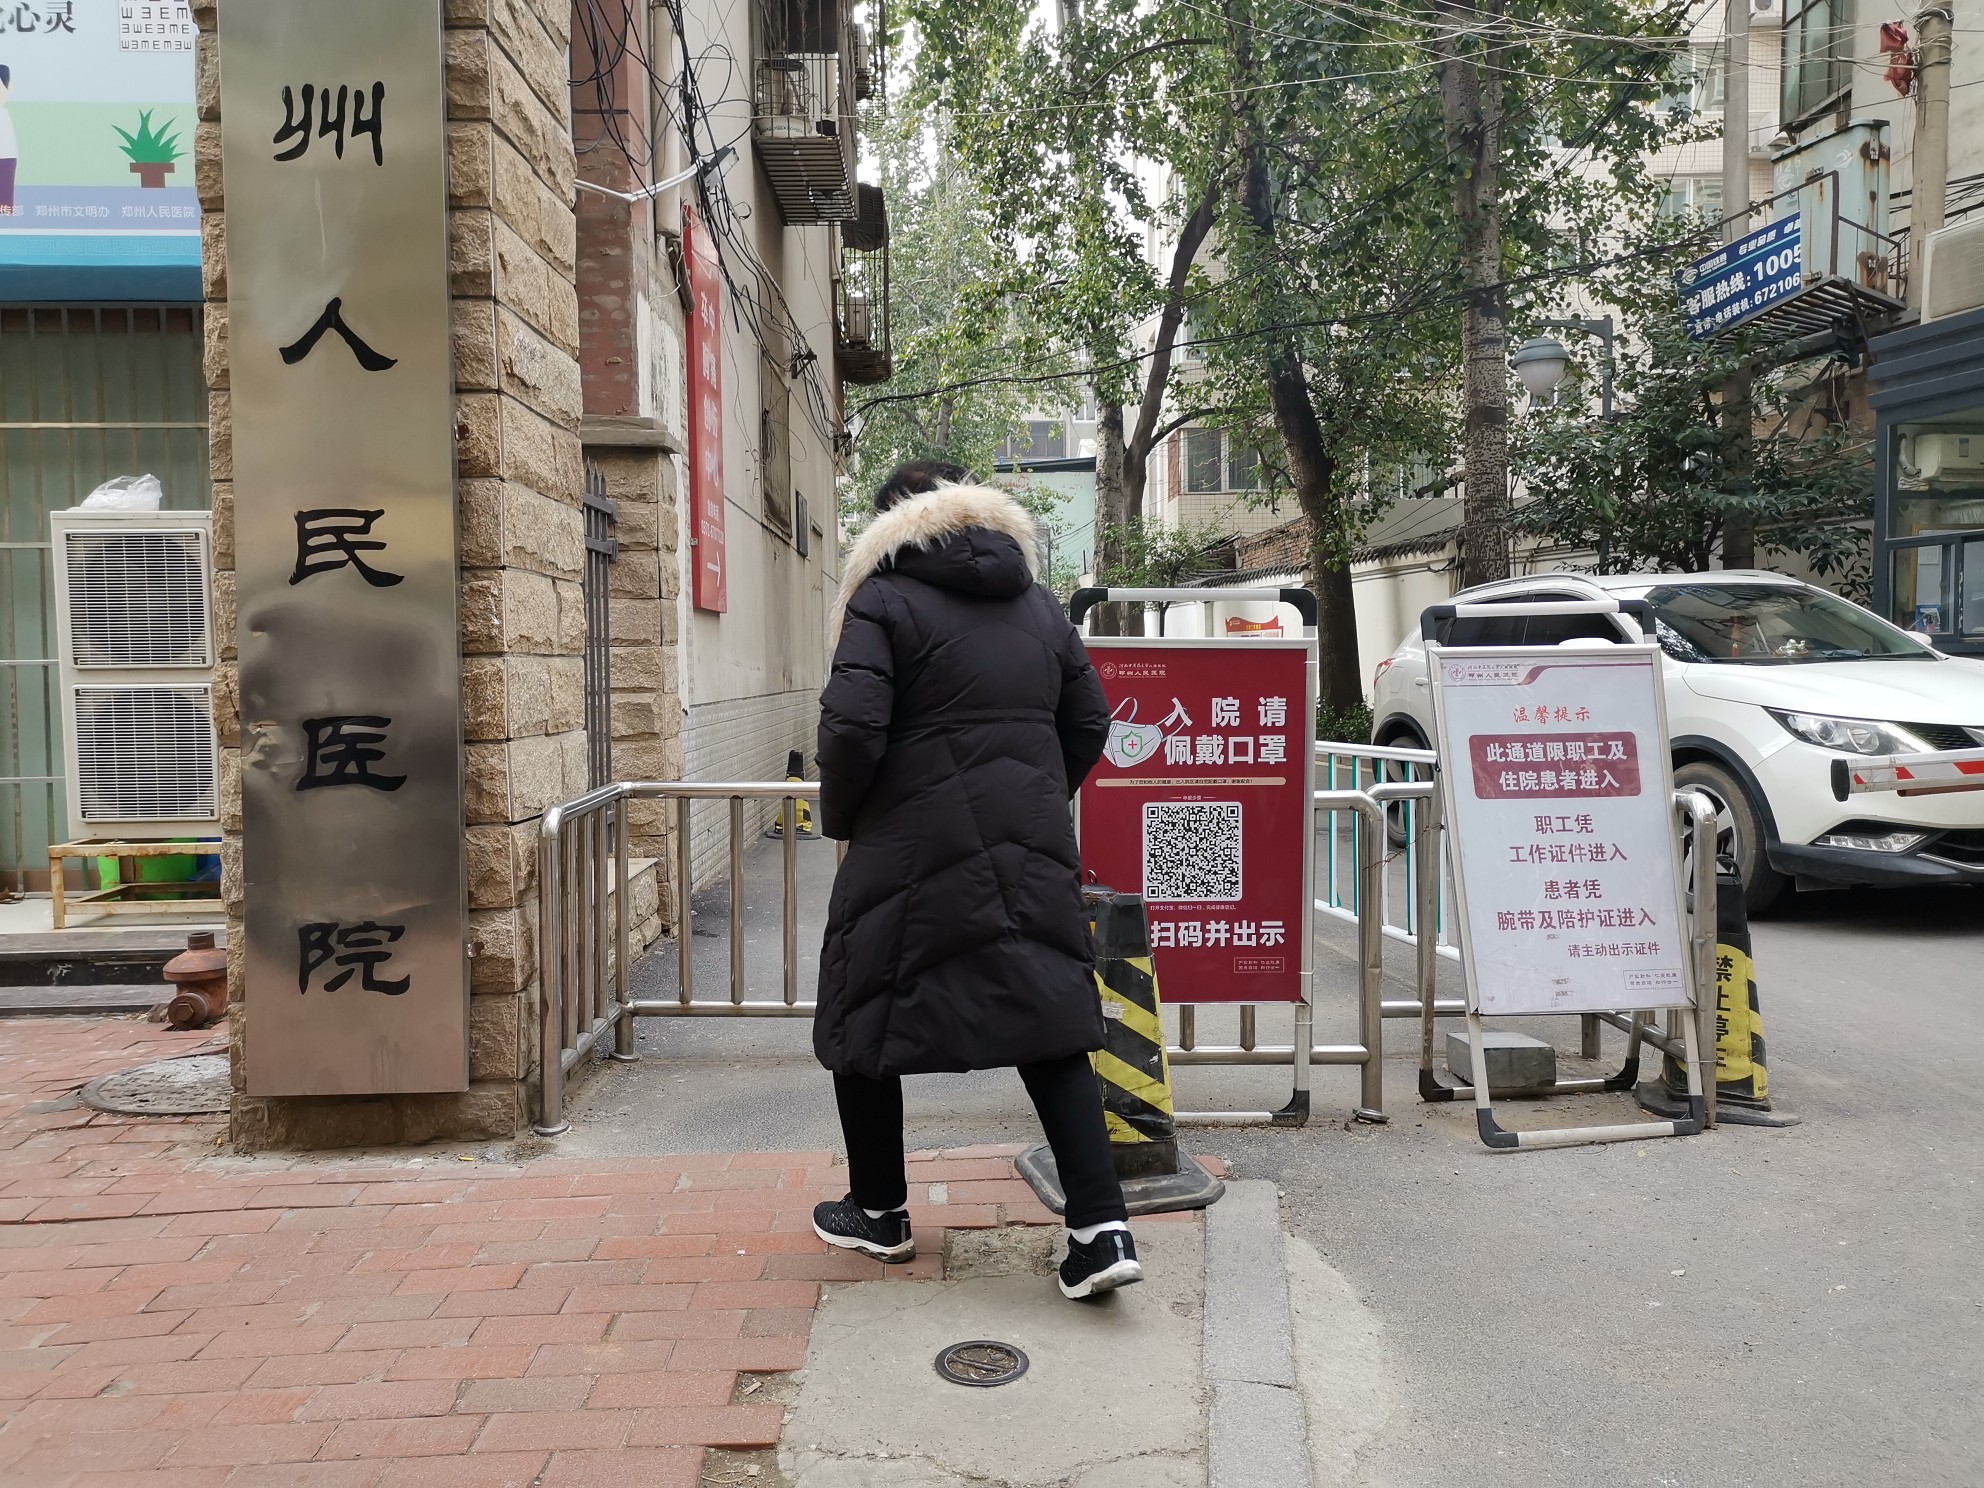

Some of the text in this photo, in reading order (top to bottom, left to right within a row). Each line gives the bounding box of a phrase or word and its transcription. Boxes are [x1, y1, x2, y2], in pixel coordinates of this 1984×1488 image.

[35, 205, 110, 218] 郑州市文明办
[121, 205, 196, 218] 郑州人民医院
[1685, 271, 1752, 316] 客服热线：
[1753, 272, 1801, 305] 672106
[271, 79, 412, 997] 州人民医院
[1164, 696, 1287, 728] 入院请
[1512, 705, 1591, 724] 温馨提示
[1164, 734, 1287, 766] 佩戴口罩
[1486, 740, 1628, 763] 此通道限职工及
[1498, 770, 1621, 793] 住院患者进入
[1533, 814, 1595, 835] 职工凭
[1508, 842, 1629, 864] 工作证件进入
[1543, 878, 1603, 900] 患者凭
[1496, 907, 1657, 932] 腕带及陪护证进入
[1150, 920, 1286, 949] 扫码并出示
[1567, 941, 1661, 959] 请主动出示证件
